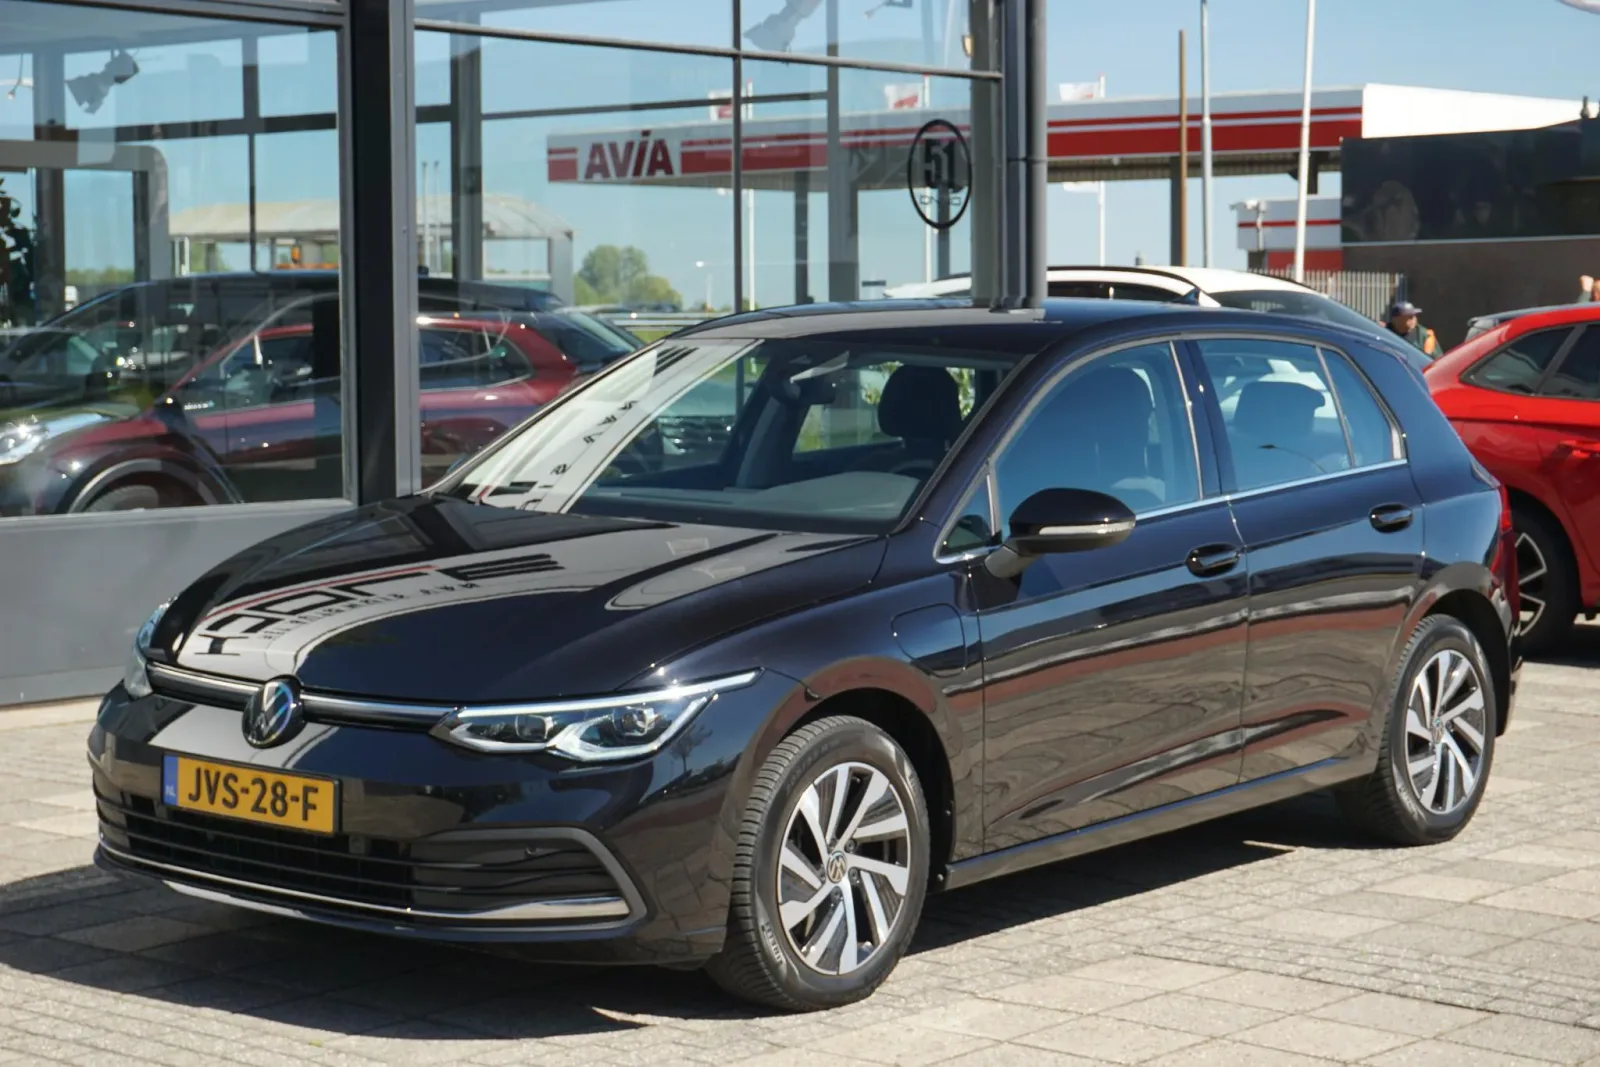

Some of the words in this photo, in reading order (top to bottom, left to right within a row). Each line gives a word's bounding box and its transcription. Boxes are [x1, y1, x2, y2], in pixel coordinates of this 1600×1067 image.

[924, 138, 956, 190] 51
[165, 785, 176, 797] NL
[188, 767, 319, 822] JVS-28-F
